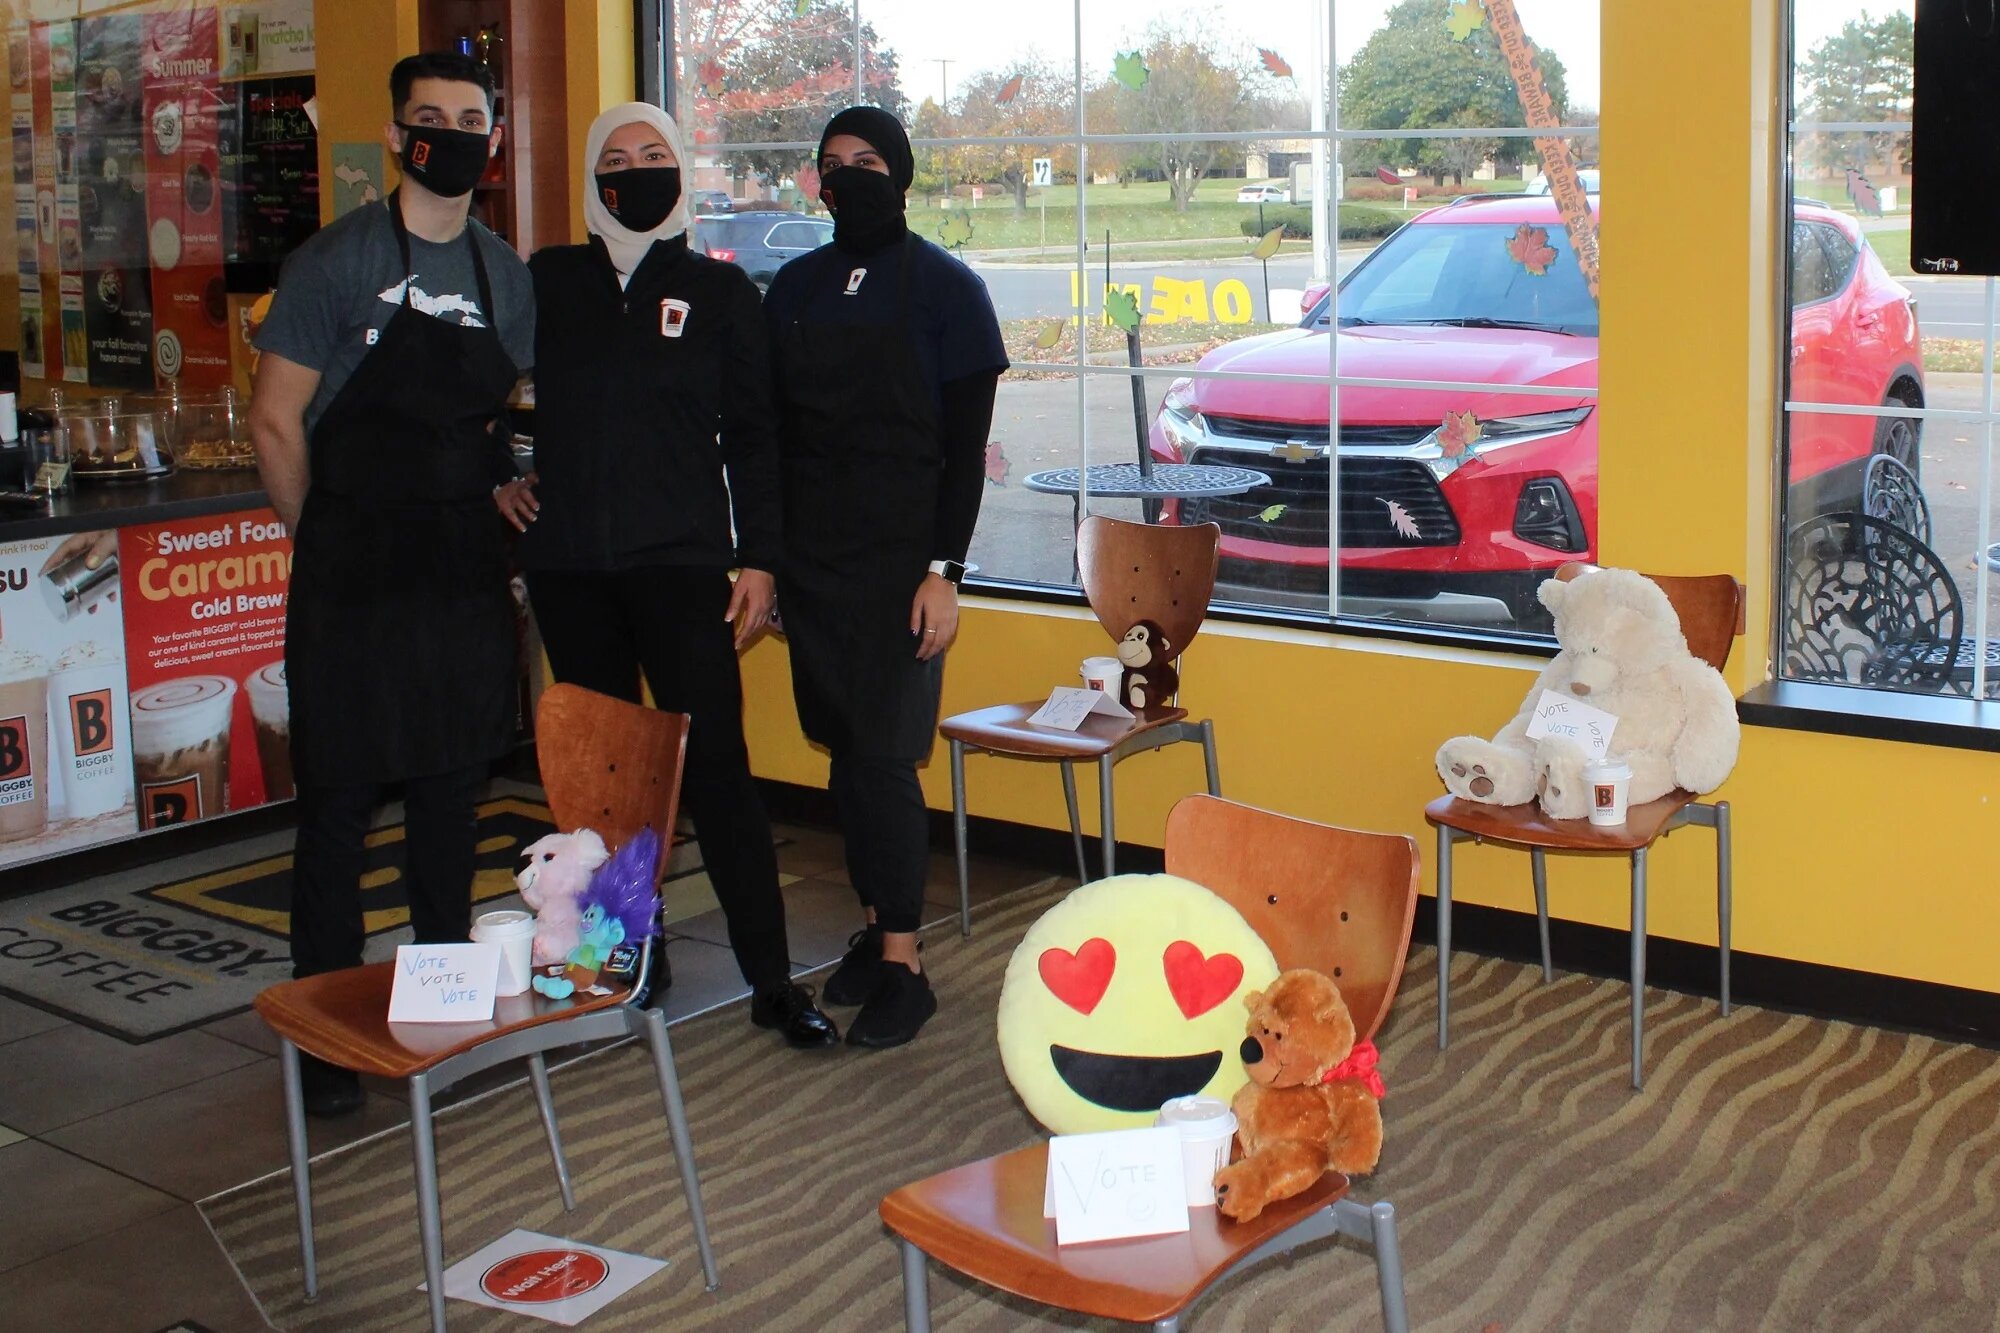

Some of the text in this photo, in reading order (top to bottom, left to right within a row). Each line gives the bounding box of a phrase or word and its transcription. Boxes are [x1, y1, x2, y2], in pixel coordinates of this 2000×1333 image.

[152, 56, 212, 78] Summer
[0, 545, 18, 555] rink
[21, 543, 27, 551] it
[158, 523, 233, 555] Sweet
[139, 551, 294, 601] Caram
[191, 593, 283, 620] Cold Brew
[148, 649, 163, 657] our
[163, 646, 179, 655] one
[180, 642, 188, 653] of
[189, 640, 206, 650] kind
[207, 634, 239, 647] caramel
[247, 628, 275, 641] topped
[152, 634, 171, 645] Your
[172, 629, 202, 641] favorite
[239, 618, 256, 629] cold
[257, 616, 277, 626] brew
[154, 656, 190, 669] delicious,
[191, 651, 214, 662] sweet
[215, 647, 240, 658] cream
[241, 640, 273, 653] flavored
[1538, 703, 1568, 718] VOTE
[76, 699, 107, 751] B
[1547, 722, 1579, 737] VOTE
[1587, 721, 1605, 748] VOTE
[75, 753, 114, 768] BIGGBY
[0, 778, 33, 793] IGGBY
[77, 767, 115, 781] COFFEE
[0, 791, 33, 805] OFFEE
[403, 951, 448, 976] VOTE
[420, 972, 466, 986] VOTE
[441, 988, 478, 1004] VOTE
[1060, 1149, 1157, 1214] VOTE
[502, 1275, 543, 1296] Wait
[538, 1254, 579, 1276] Here
